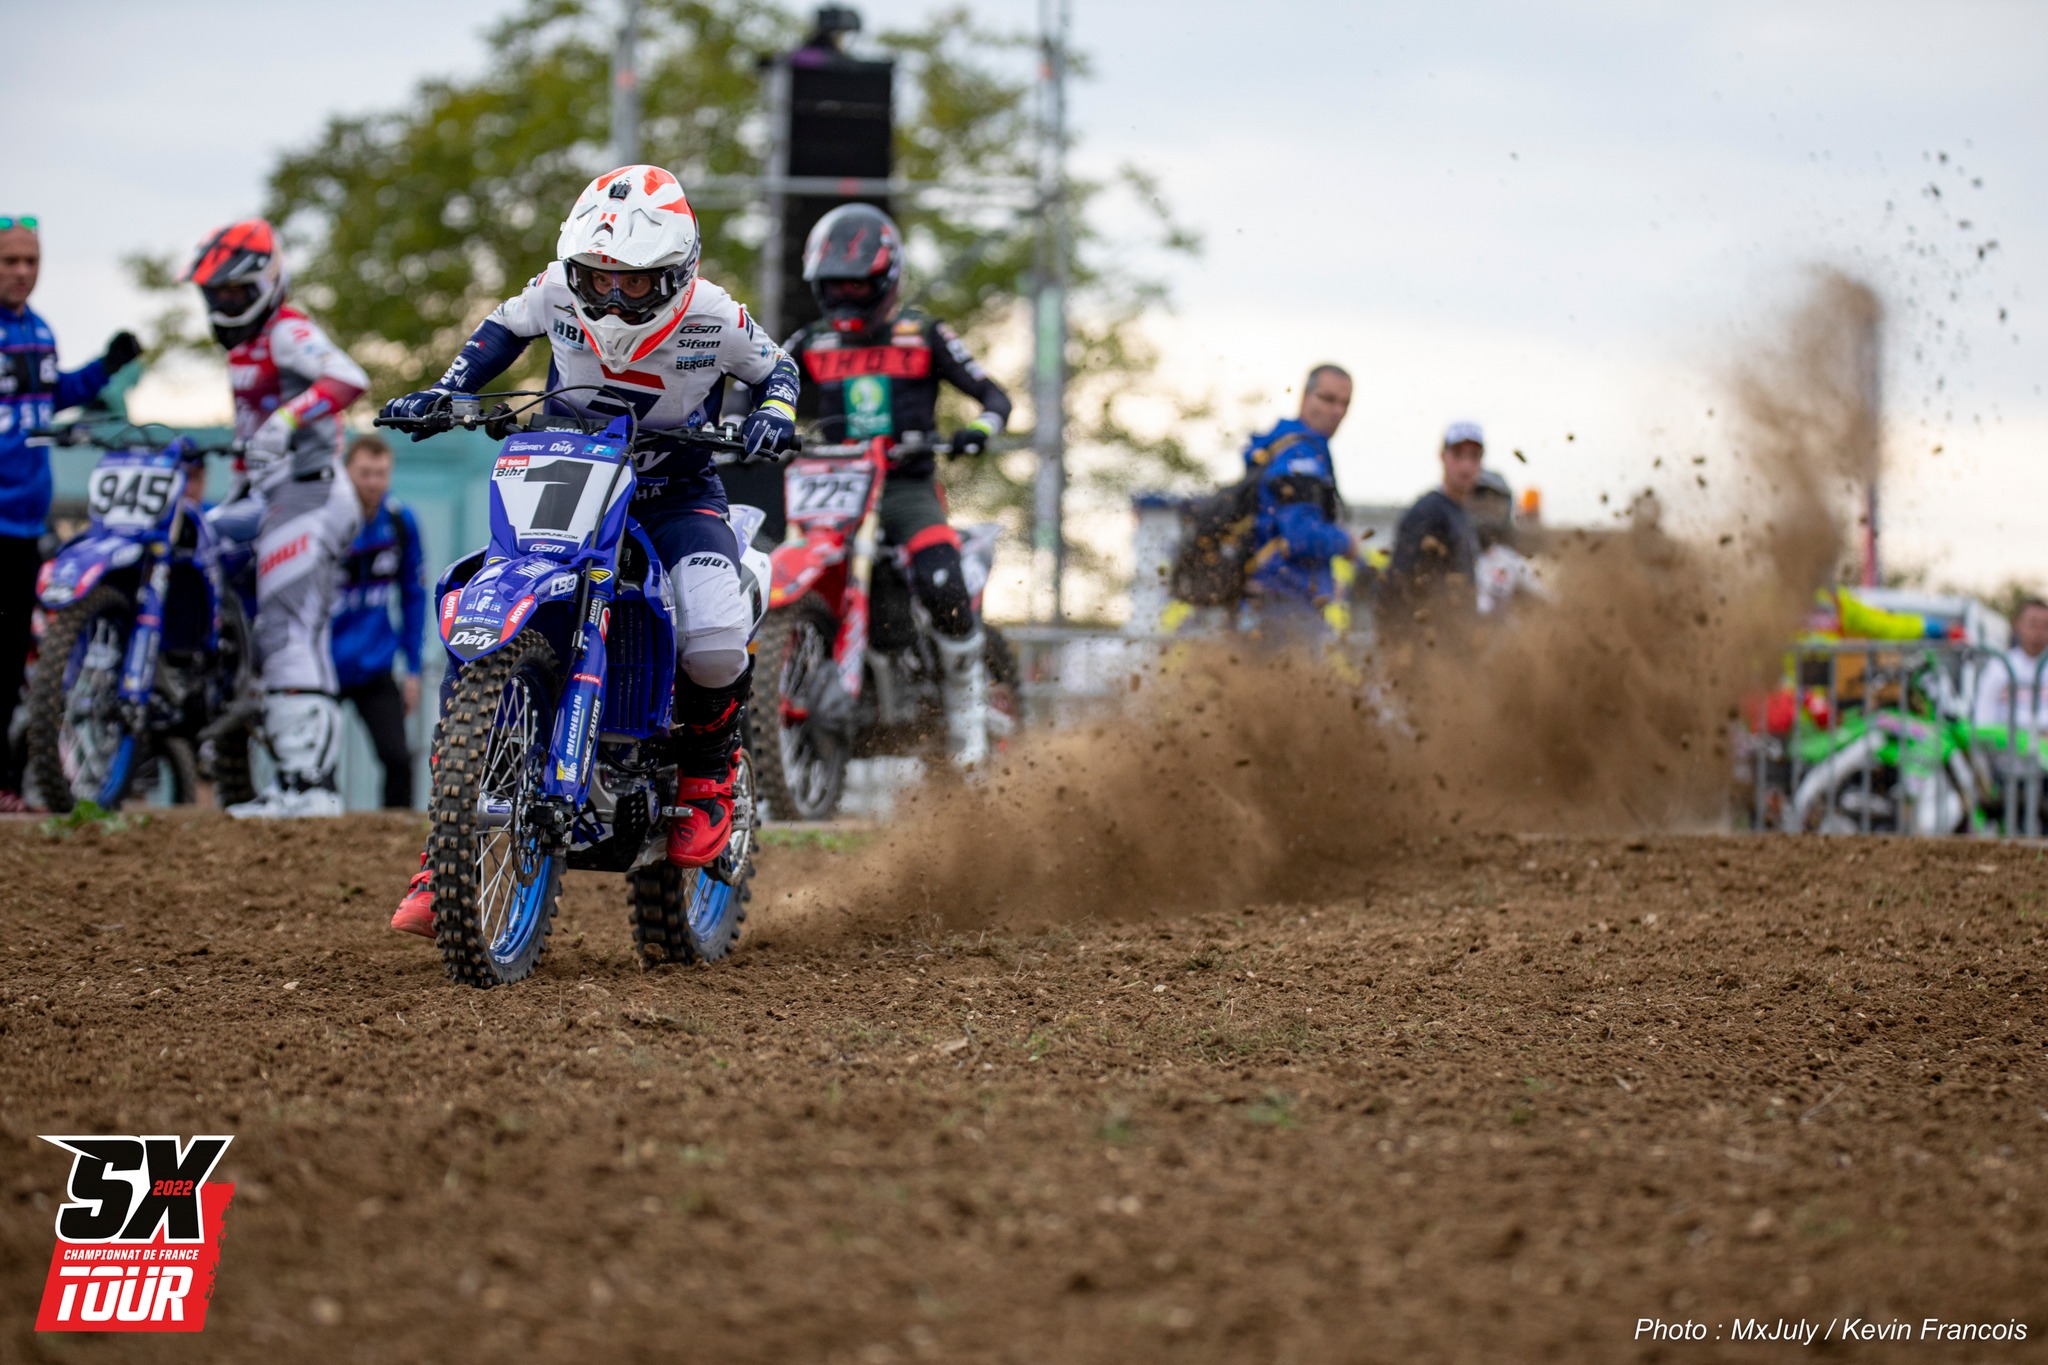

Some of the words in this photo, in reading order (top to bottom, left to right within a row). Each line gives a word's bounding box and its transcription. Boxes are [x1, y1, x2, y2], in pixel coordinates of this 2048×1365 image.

[680, 325, 722, 334] GSM
[677, 339, 721, 349] Sifam
[676, 359, 715, 370] BERGER
[509, 444, 545, 452] DESPREY
[549, 442, 575, 454] Dafy
[495, 467, 526, 477] Bihr
[94, 474, 174, 515] 945
[524, 460, 594, 531] 1
[529, 543, 566, 554] GSM
[688, 556, 731, 569] SHOT
[444, 595, 457, 619] MOTUL
[509, 601, 531, 624] MOTUL
[449, 631, 499, 650] Dafy
[566, 694, 582, 756] MICHELIN
[589, 699, 601, 738] GALFER
